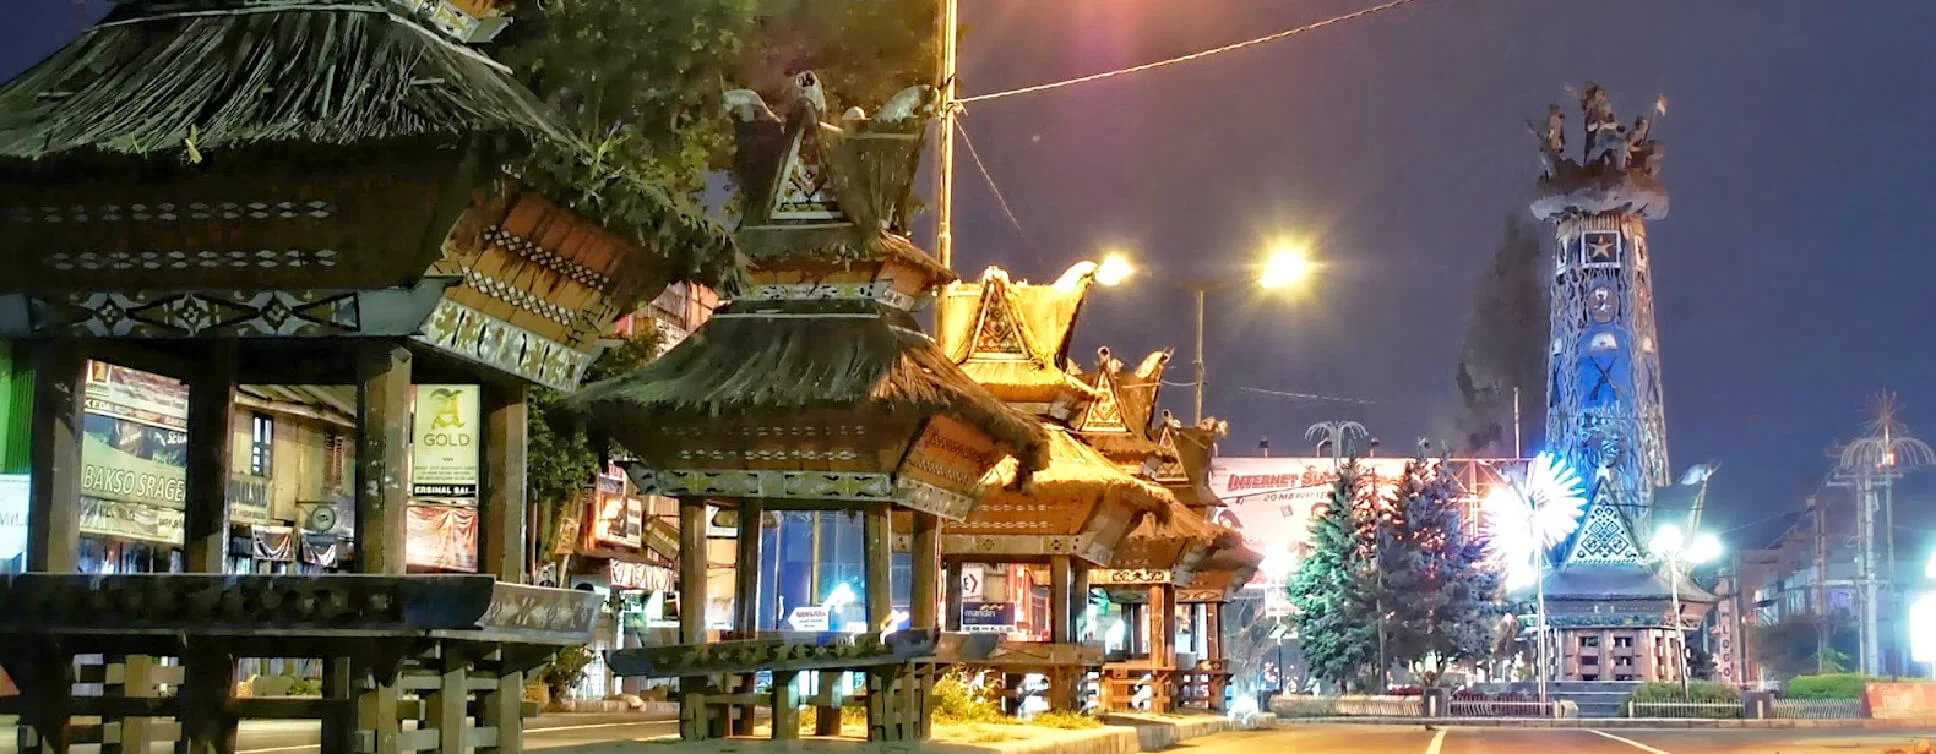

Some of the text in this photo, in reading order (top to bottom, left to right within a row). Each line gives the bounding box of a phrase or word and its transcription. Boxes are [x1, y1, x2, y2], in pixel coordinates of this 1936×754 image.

[423, 433, 470, 447] GOLD
[83, 465, 186, 503] BAKSO SRAGE
[1227, 474, 1298, 491] INTERNET
[964, 610, 996, 618] mandiri
